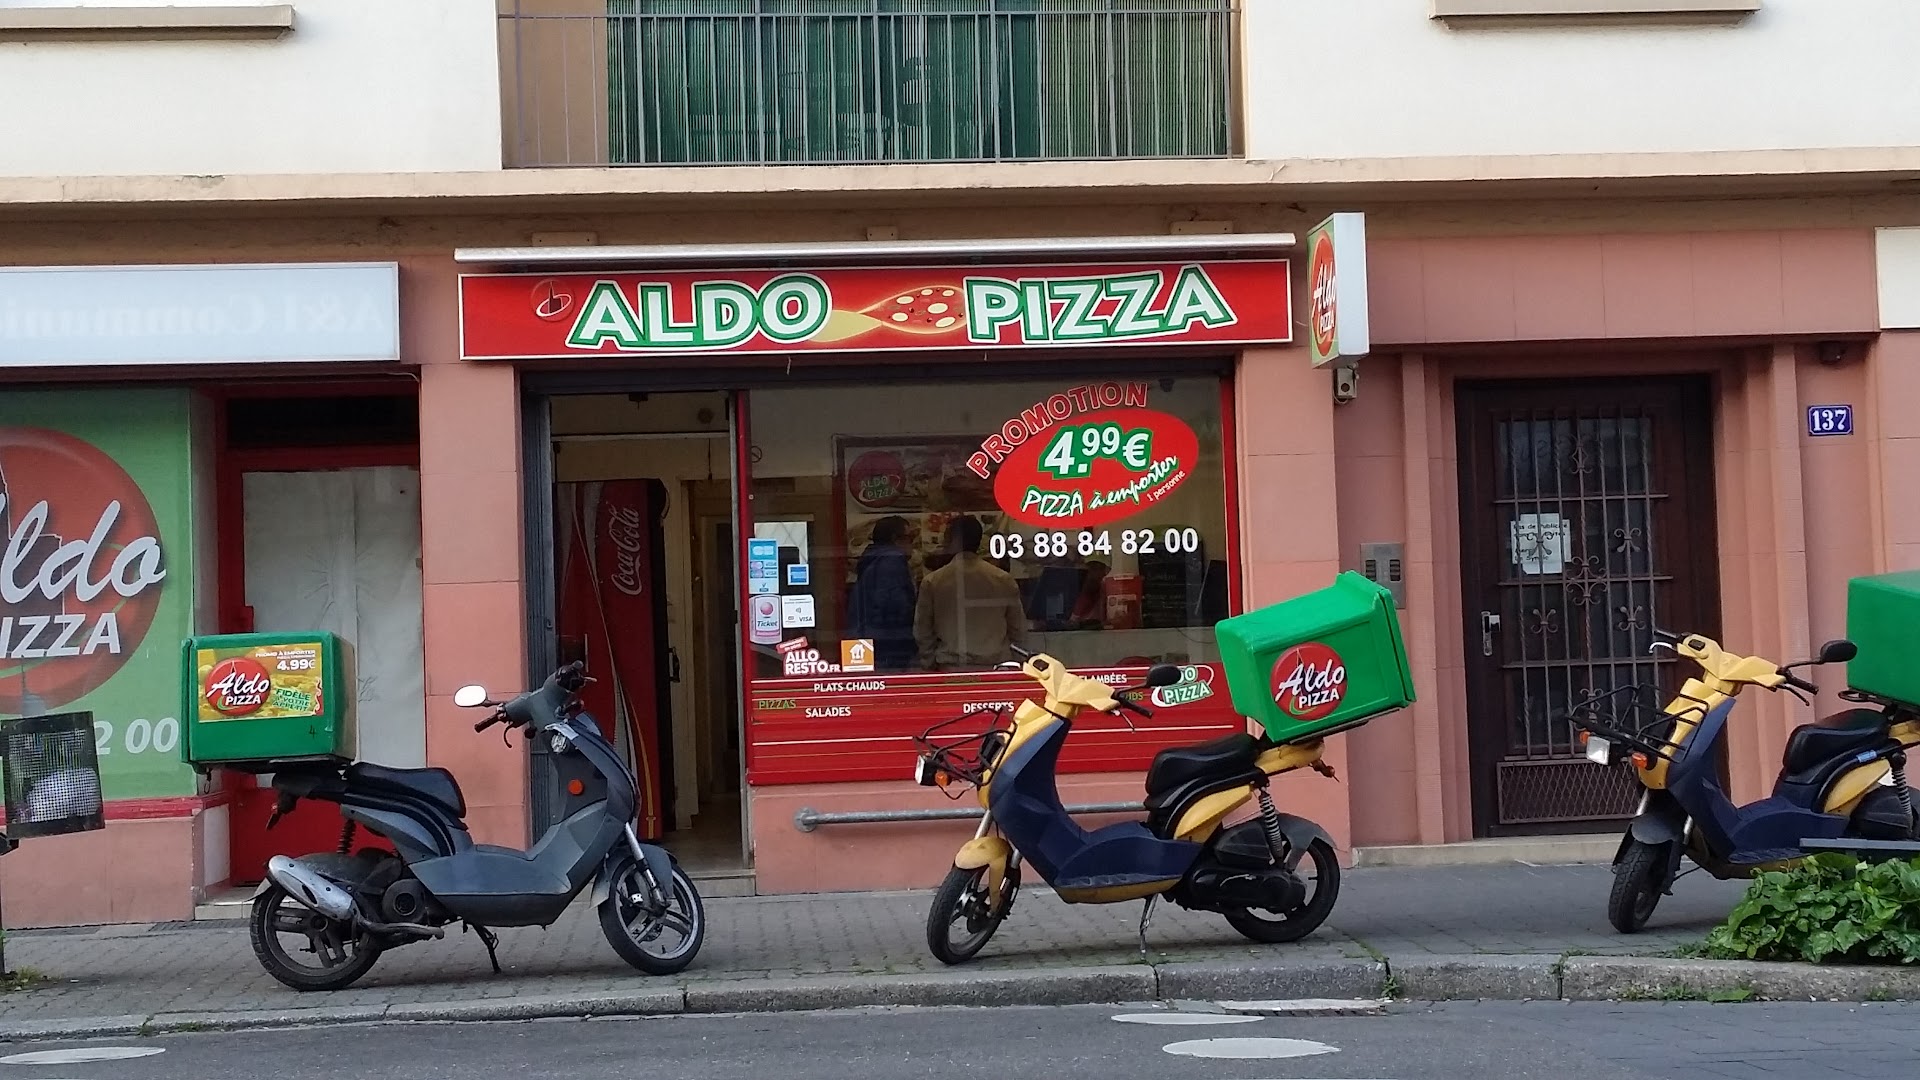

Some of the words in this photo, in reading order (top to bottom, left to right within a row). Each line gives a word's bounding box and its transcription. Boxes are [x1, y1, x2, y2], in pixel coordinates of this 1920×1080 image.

[1311, 262, 1337, 318] Aldo
[567, 274, 831, 350] ALDO
[964, 266, 1236, 342] PIZZA
[1319, 309, 1335, 335] PIZZA
[966, 380, 1148, 480] PROMOTION
[1812, 409, 1847, 431] 137
[1043, 426, 1150, 476] 4.99€
[1021, 489, 1084, 517] PIZZA
[1089, 491, 1104, 510] à
[1104, 454, 1178, 505] emporter
[1153, 469, 1186, 501] personne
[0, 493, 166, 604] ldo
[989, 533, 1024, 559] 03
[1033, 531, 1068, 557] 88
[1076, 530, 1112, 556] 84
[1121, 528, 1155, 554] 82
[1164, 527, 1199, 553] 00
[0, 613, 121, 658] IZZA
[276, 659, 316, 671] 4.99€
[785, 649, 819, 663] ALLO
[785, 660, 841, 675] RESTO.FR
[206, 672, 270, 698] Aldo
[814, 682, 844, 692] PLATS
[846, 681, 886, 691] CHAUDS
[1078, 672, 1127, 684] LAMBÉES
[1275, 658, 1345, 702] Aldo
[225, 695, 262, 706] PIZZA
[758, 699, 797, 710] PIZZAS
[1164, 681, 1211, 705] PIZZA
[1298, 688, 1340, 709] PIZZA
[805, 706, 851, 718] SALADES
[125, 717, 179, 754] 00
